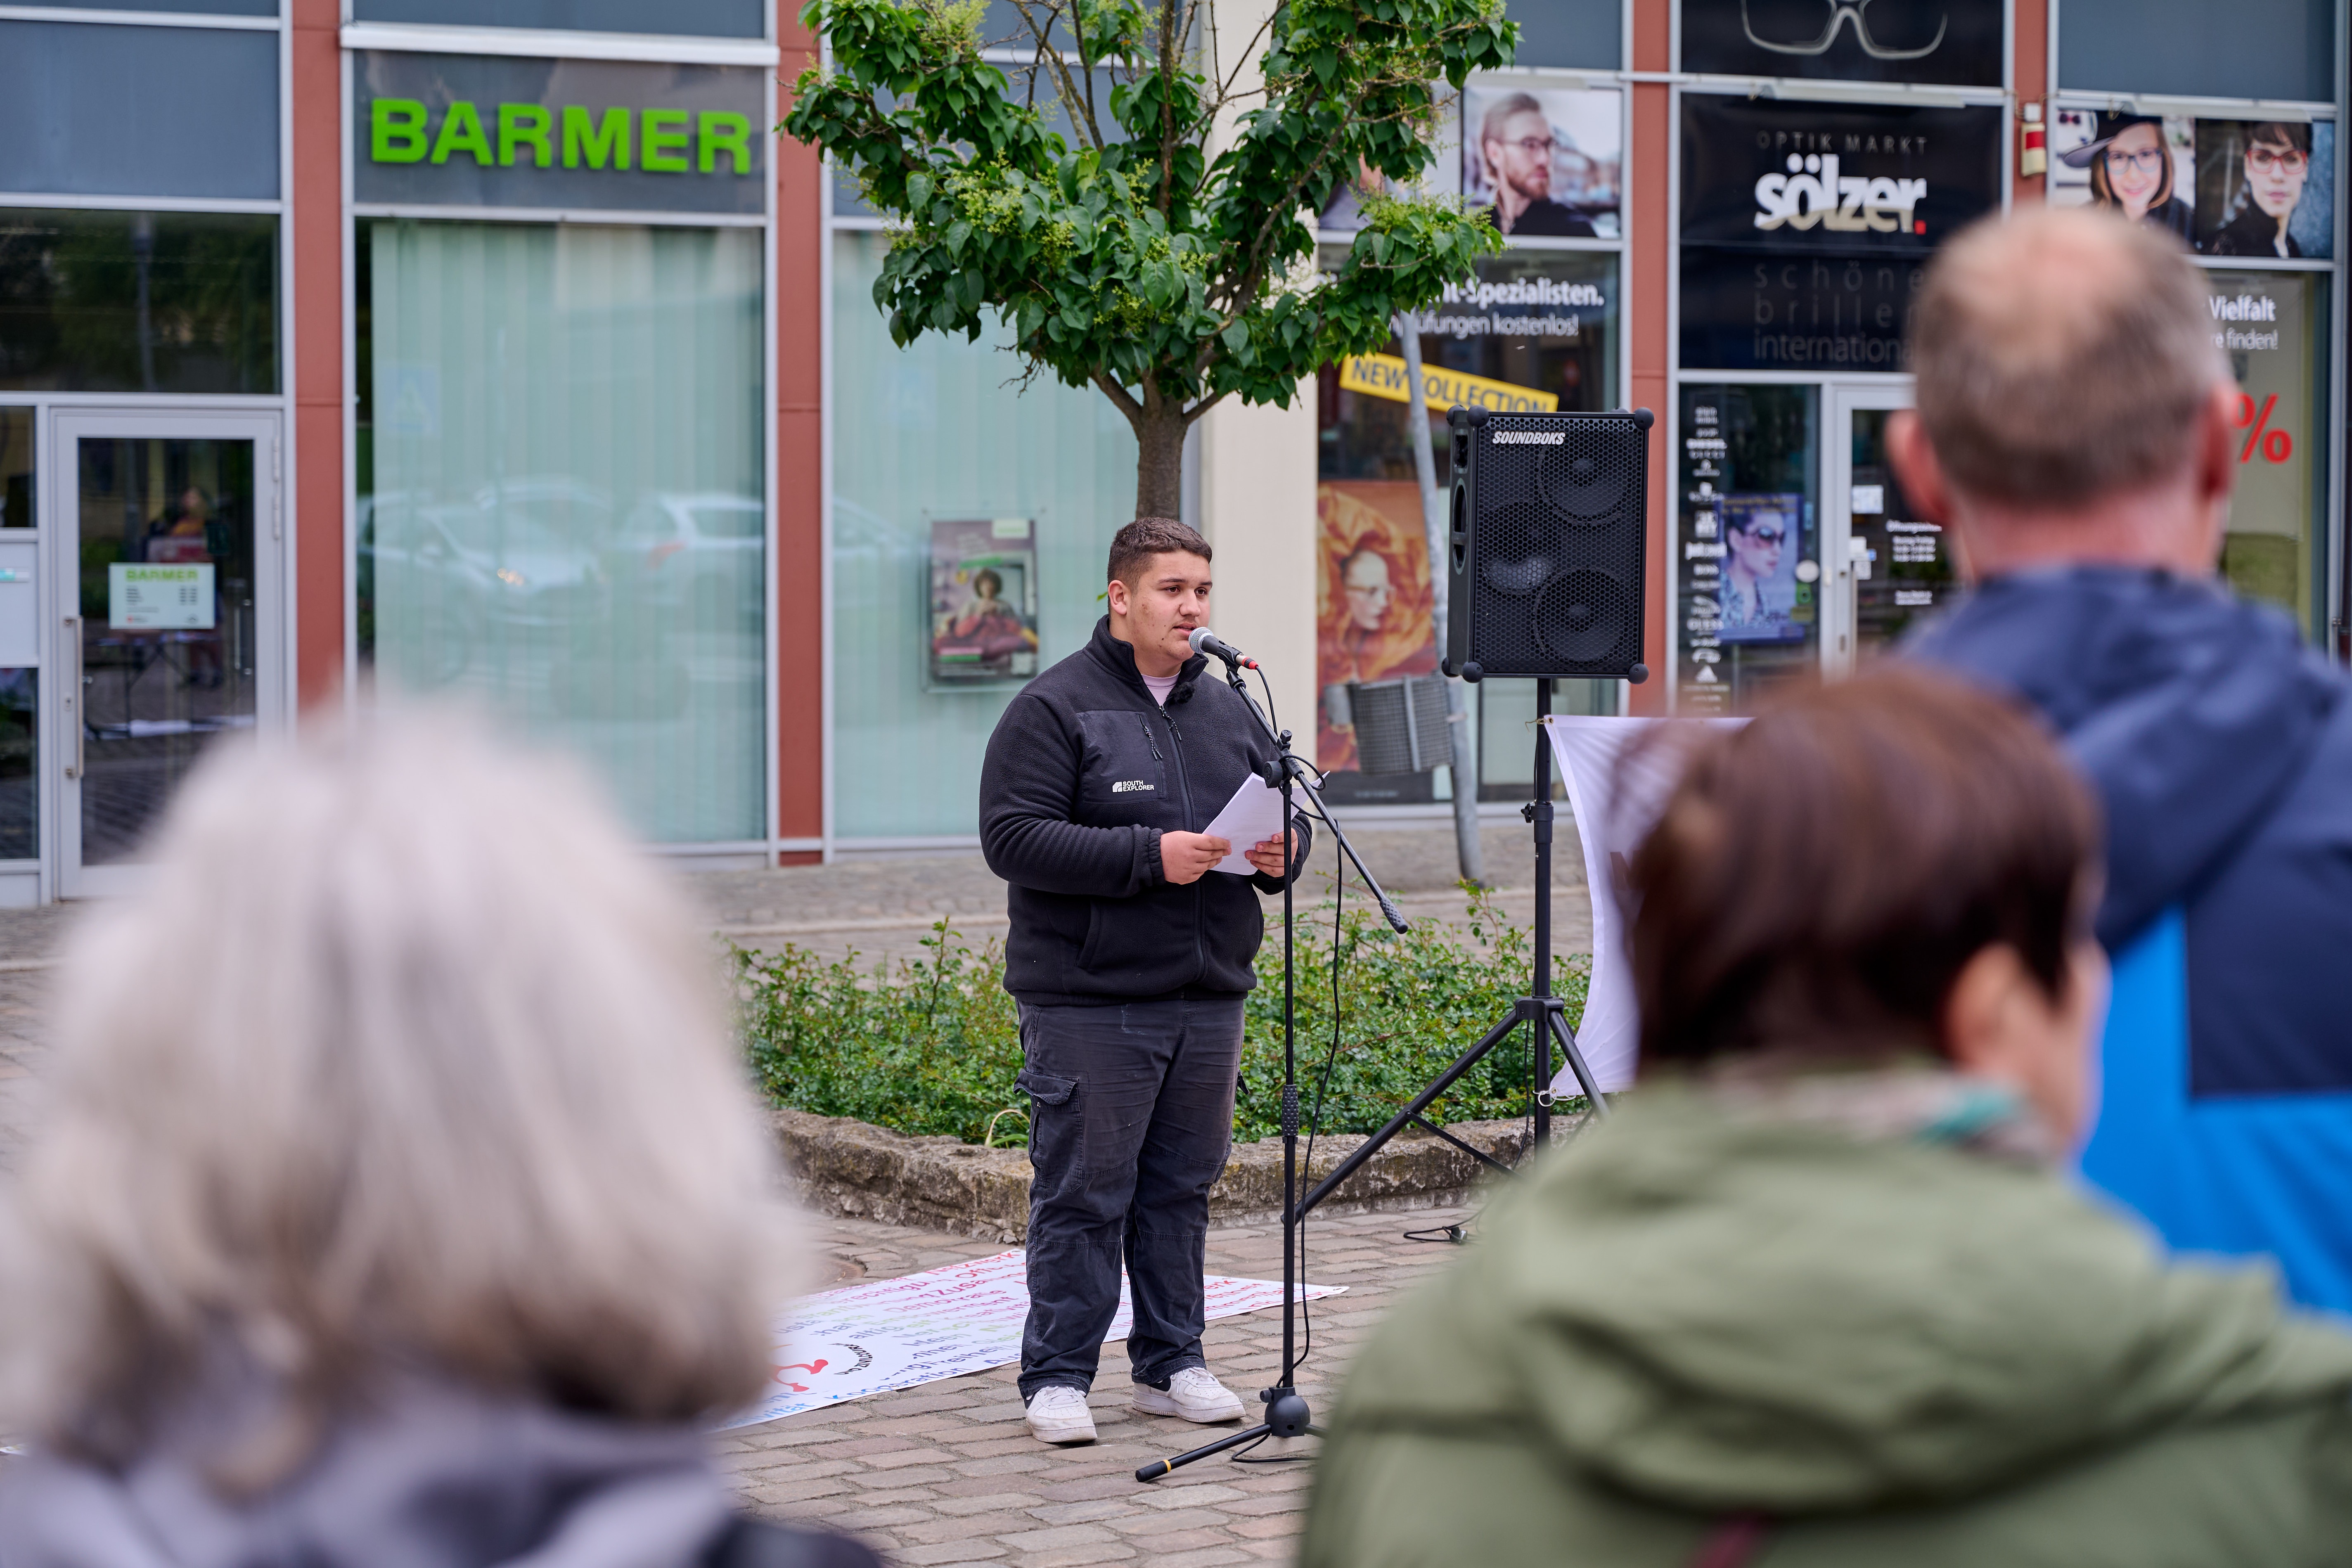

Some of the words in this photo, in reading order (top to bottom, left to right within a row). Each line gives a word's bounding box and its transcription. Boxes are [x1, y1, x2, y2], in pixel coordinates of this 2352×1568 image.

[371, 98, 752, 175] BARMER
[1757, 130, 1832, 152] OPTIK
[1845, 133, 1928, 155] MARKT
[2209, 295, 2276, 322] Vielfalt
[1492, 310, 1579, 336] kostenlos!
[2226, 327, 2279, 350] finden!
[1352, 358, 1409, 390] NEW
[1492, 431, 1566, 445] SOUNDBOKS
[126, 568, 198, 582] BARMER
[900, 1334, 971, 1346] Ideen
[824, 1367, 974, 1400] Kooperation
